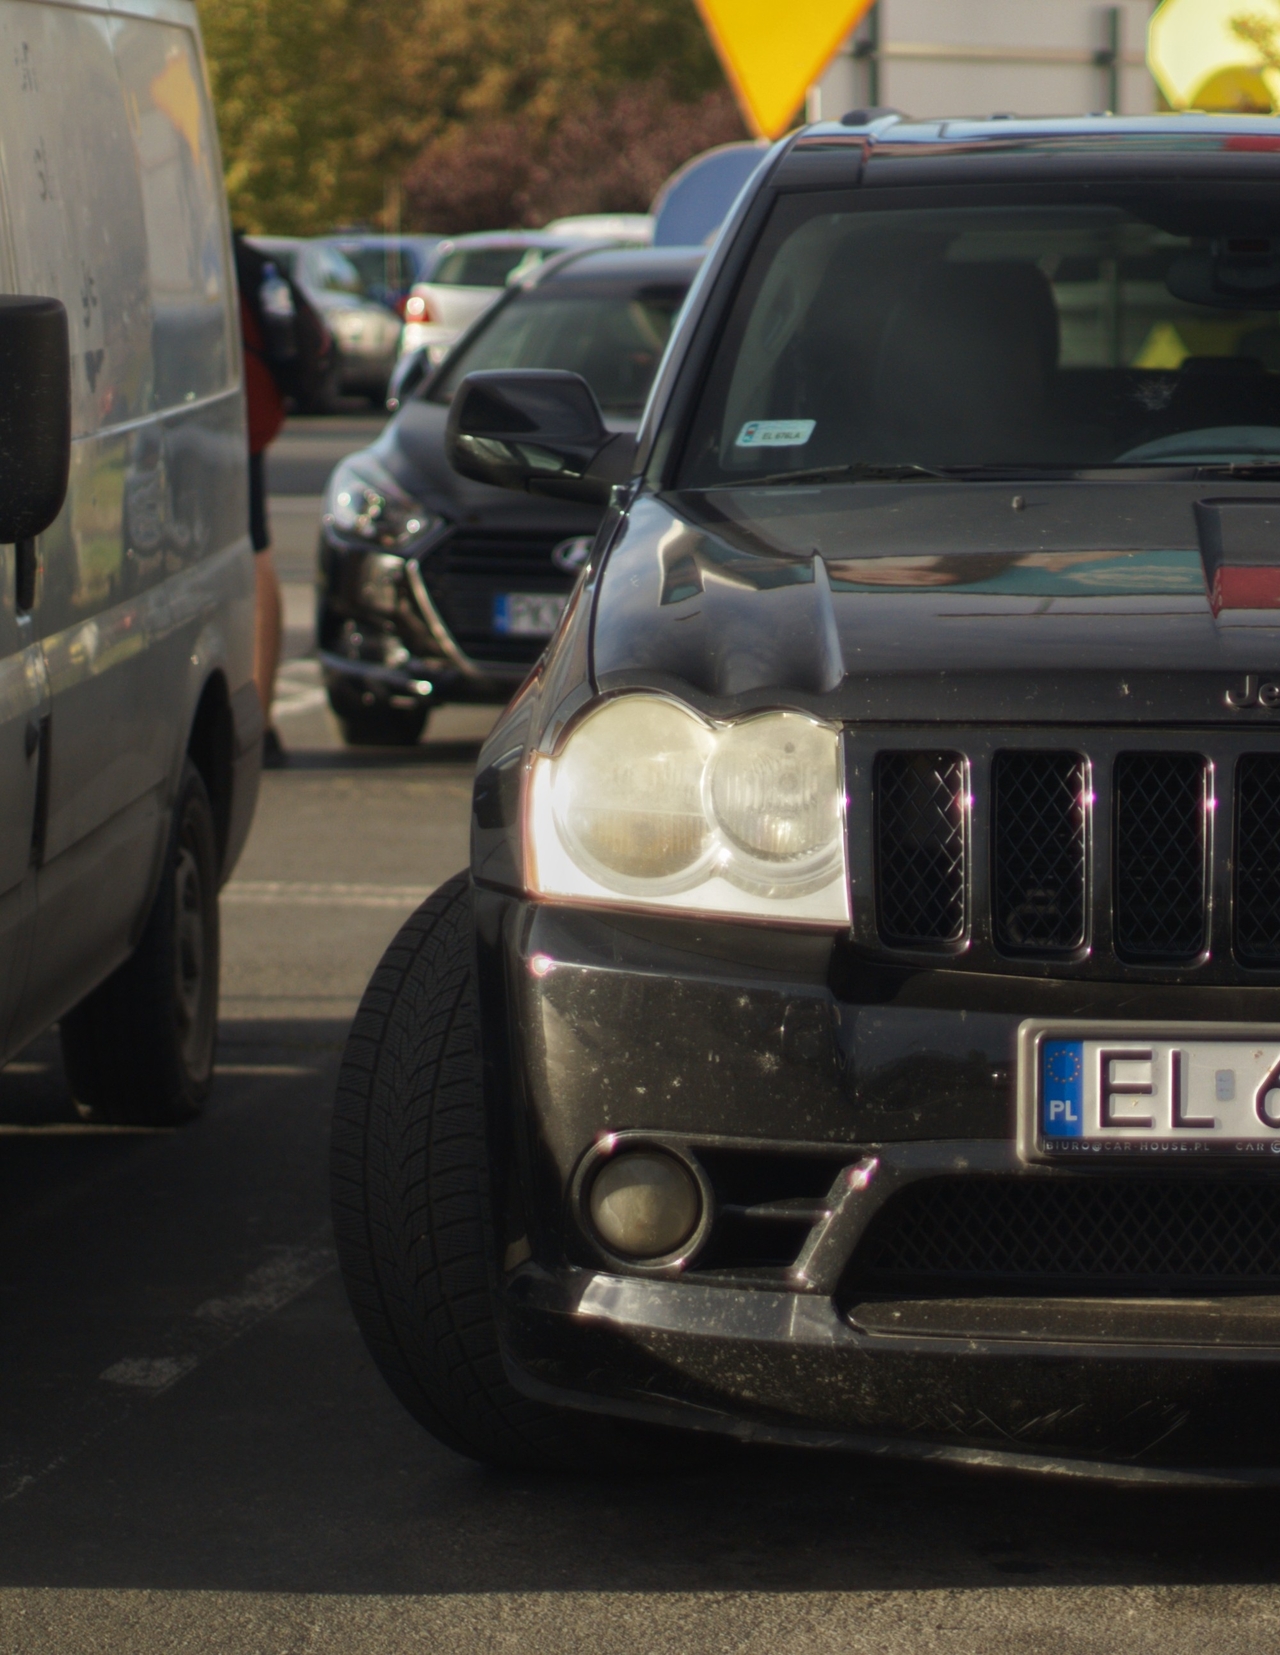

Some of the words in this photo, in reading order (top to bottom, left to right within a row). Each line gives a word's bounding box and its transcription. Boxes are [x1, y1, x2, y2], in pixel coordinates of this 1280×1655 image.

[1099, 1049, 1215, 1129] EL
[1049, 1101, 1078, 1122] PL
[1235, 1142, 1265, 1151] CAR
